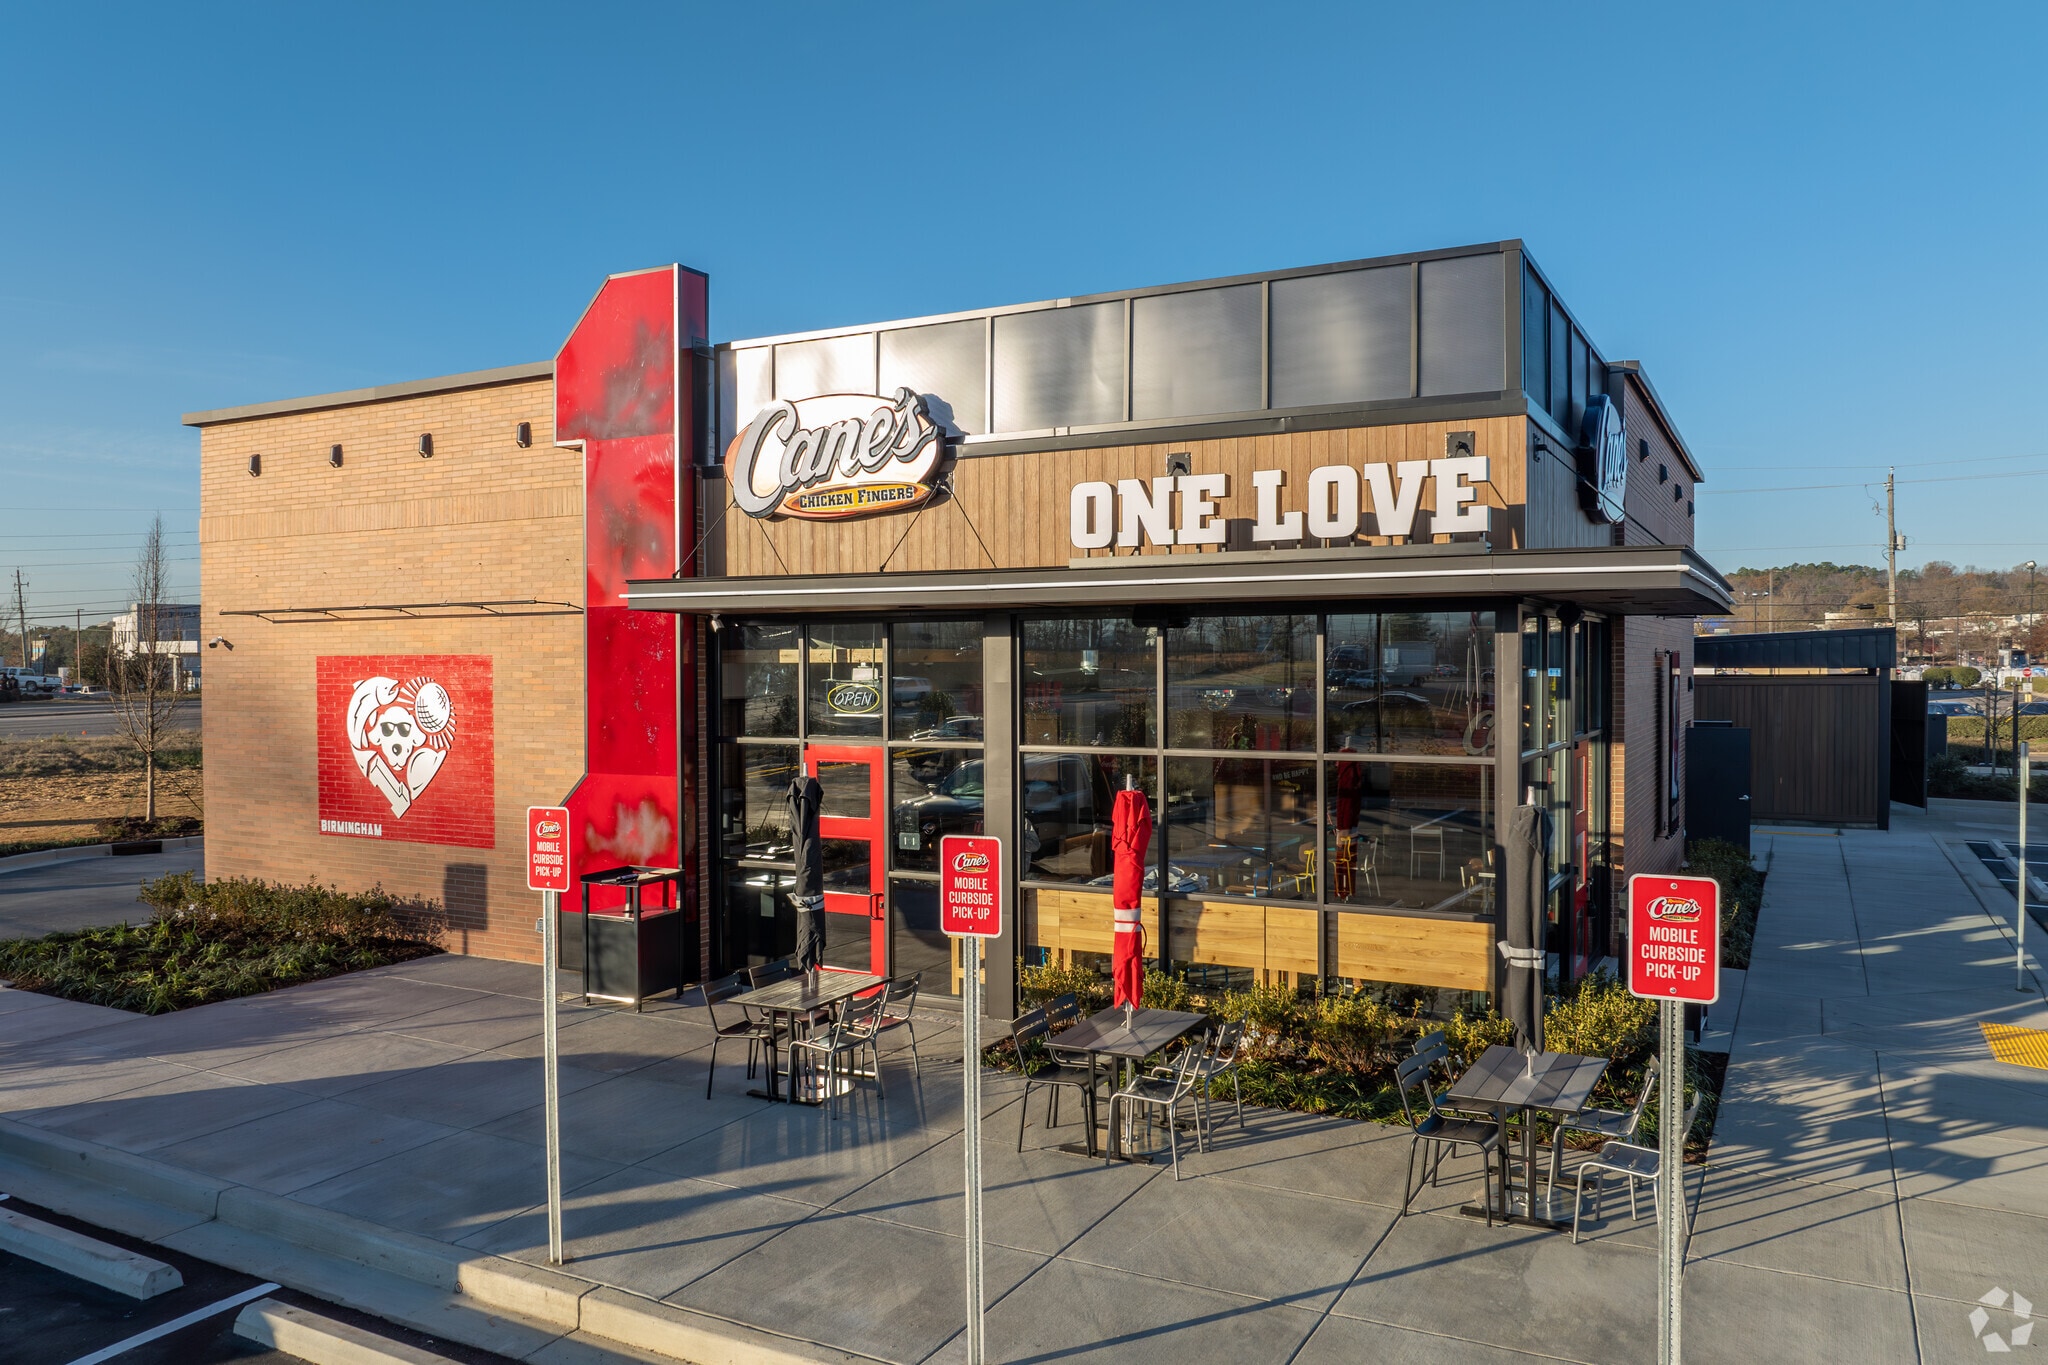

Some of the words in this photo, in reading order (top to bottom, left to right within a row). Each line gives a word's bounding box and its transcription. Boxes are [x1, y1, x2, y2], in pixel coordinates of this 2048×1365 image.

[732, 387, 945, 518] Cane's
[799, 492, 853, 508] CHICKEN
[857, 486, 914, 503] FINGERS
[1070, 473, 1228, 549] ONE
[1252, 456, 1491, 542] LOVE
[834, 691, 873, 706] OPEN
[321, 819, 382, 836] BIRMINGHAM
[536, 841, 560, 852] MOBILE
[533, 853, 564, 865] CURBSIDE
[954, 852, 990, 871] Cane's
[535, 866, 562, 877] PICK-UP
[954, 877, 988, 890] MOBILE
[948, 891, 994, 905] CURBSIDE
[952, 906, 990, 920] PICK-UP
[1650, 896, 1701, 919] Cane's
[1649, 926, 1698, 944] MOBILE
[1641, 944, 1706, 963] CURBSIDE
[1646, 962, 1701, 981] PICK-UP
